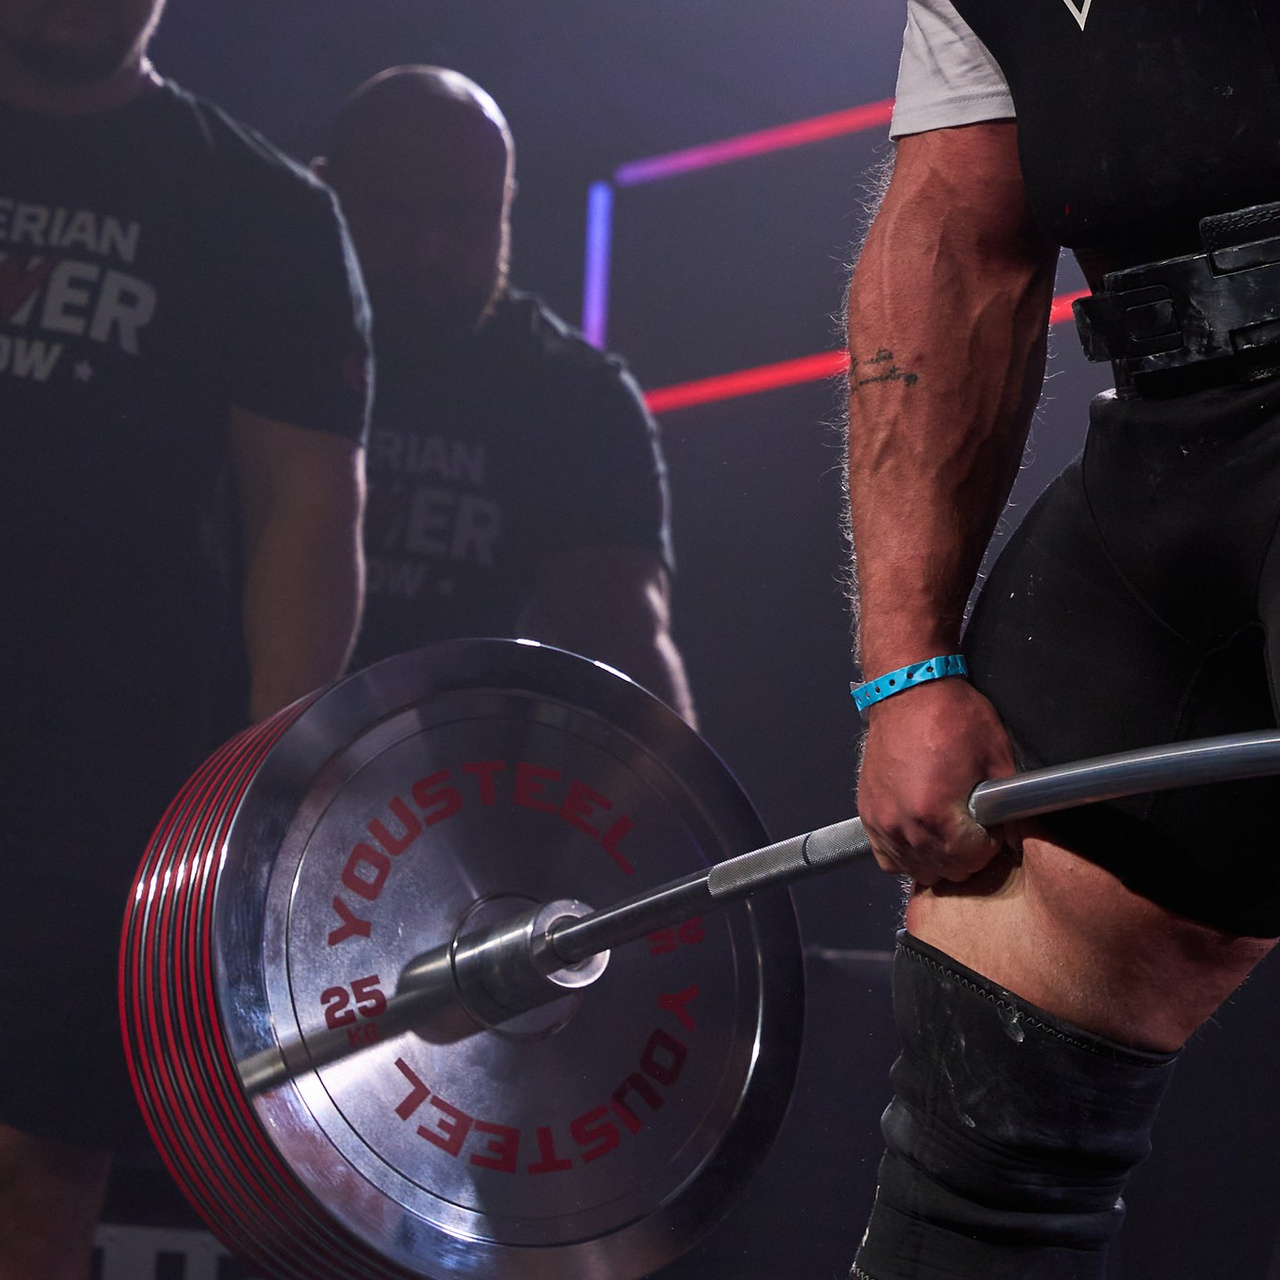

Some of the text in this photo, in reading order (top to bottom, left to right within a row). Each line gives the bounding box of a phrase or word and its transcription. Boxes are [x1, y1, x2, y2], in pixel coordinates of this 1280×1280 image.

[327, 759, 636, 947] YOUSTEEL
[321, 974, 387, 1030] 25
[394, 983, 702, 1174] YOUSTEEL
